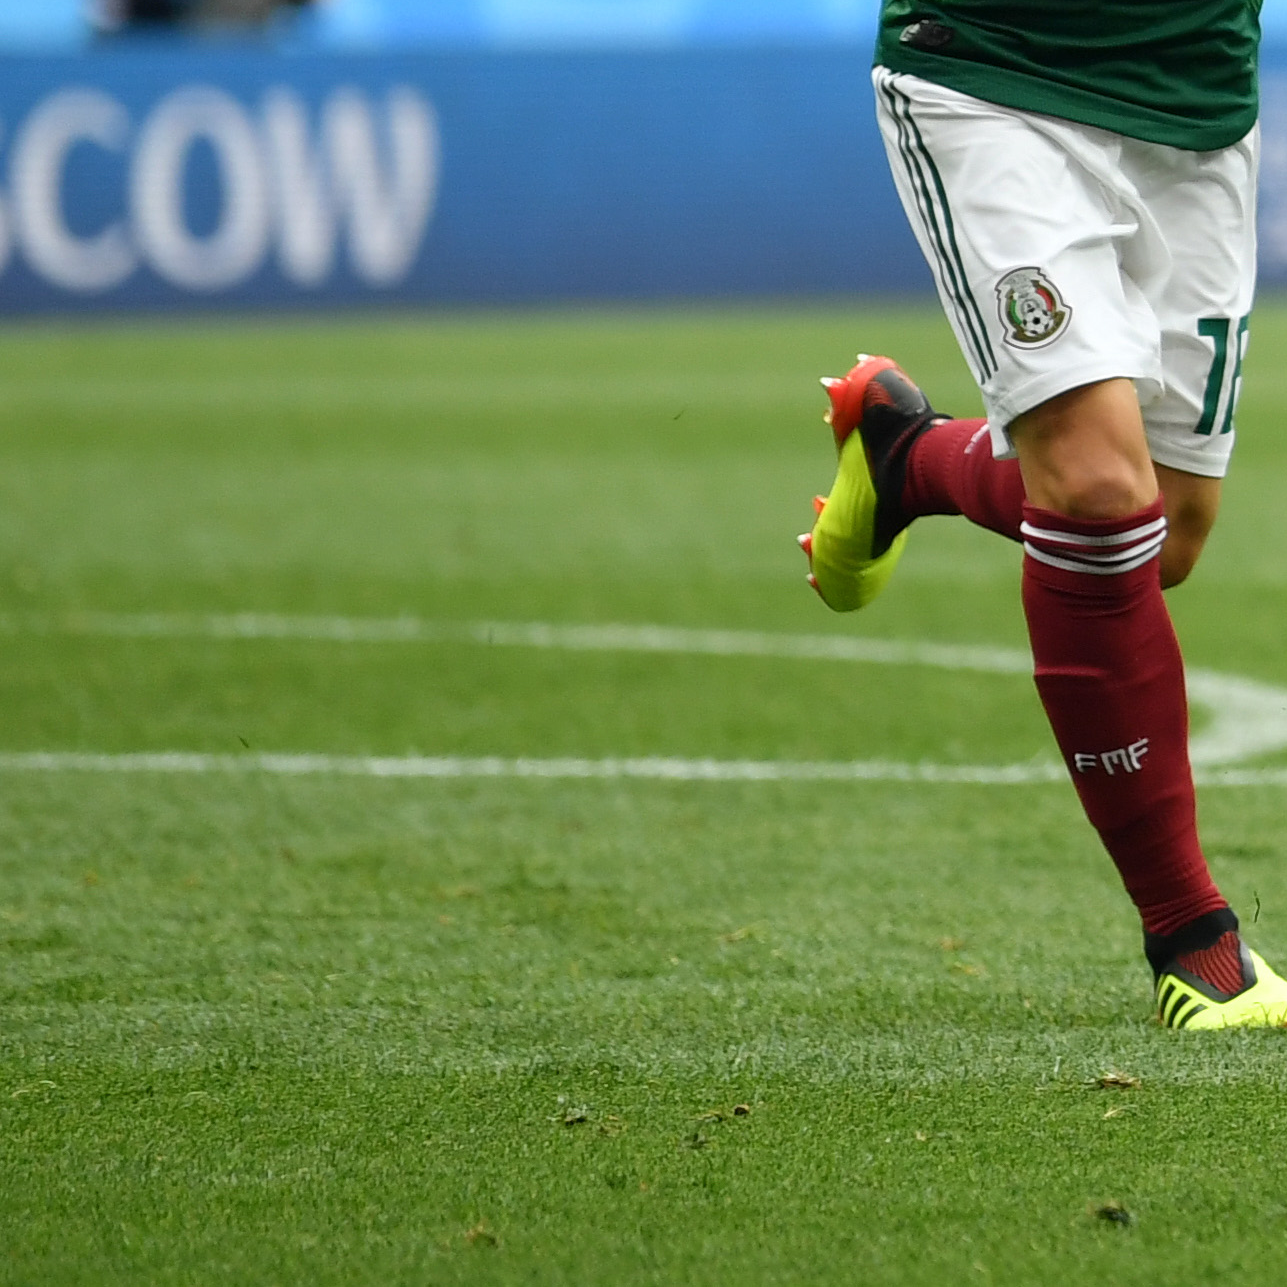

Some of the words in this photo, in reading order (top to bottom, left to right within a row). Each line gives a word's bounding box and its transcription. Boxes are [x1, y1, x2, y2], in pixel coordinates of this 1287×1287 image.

[0, 86, 441, 294] COW
[1193, 314, 1249, 436] 1
[1074, 737, 1149, 776] FMF
